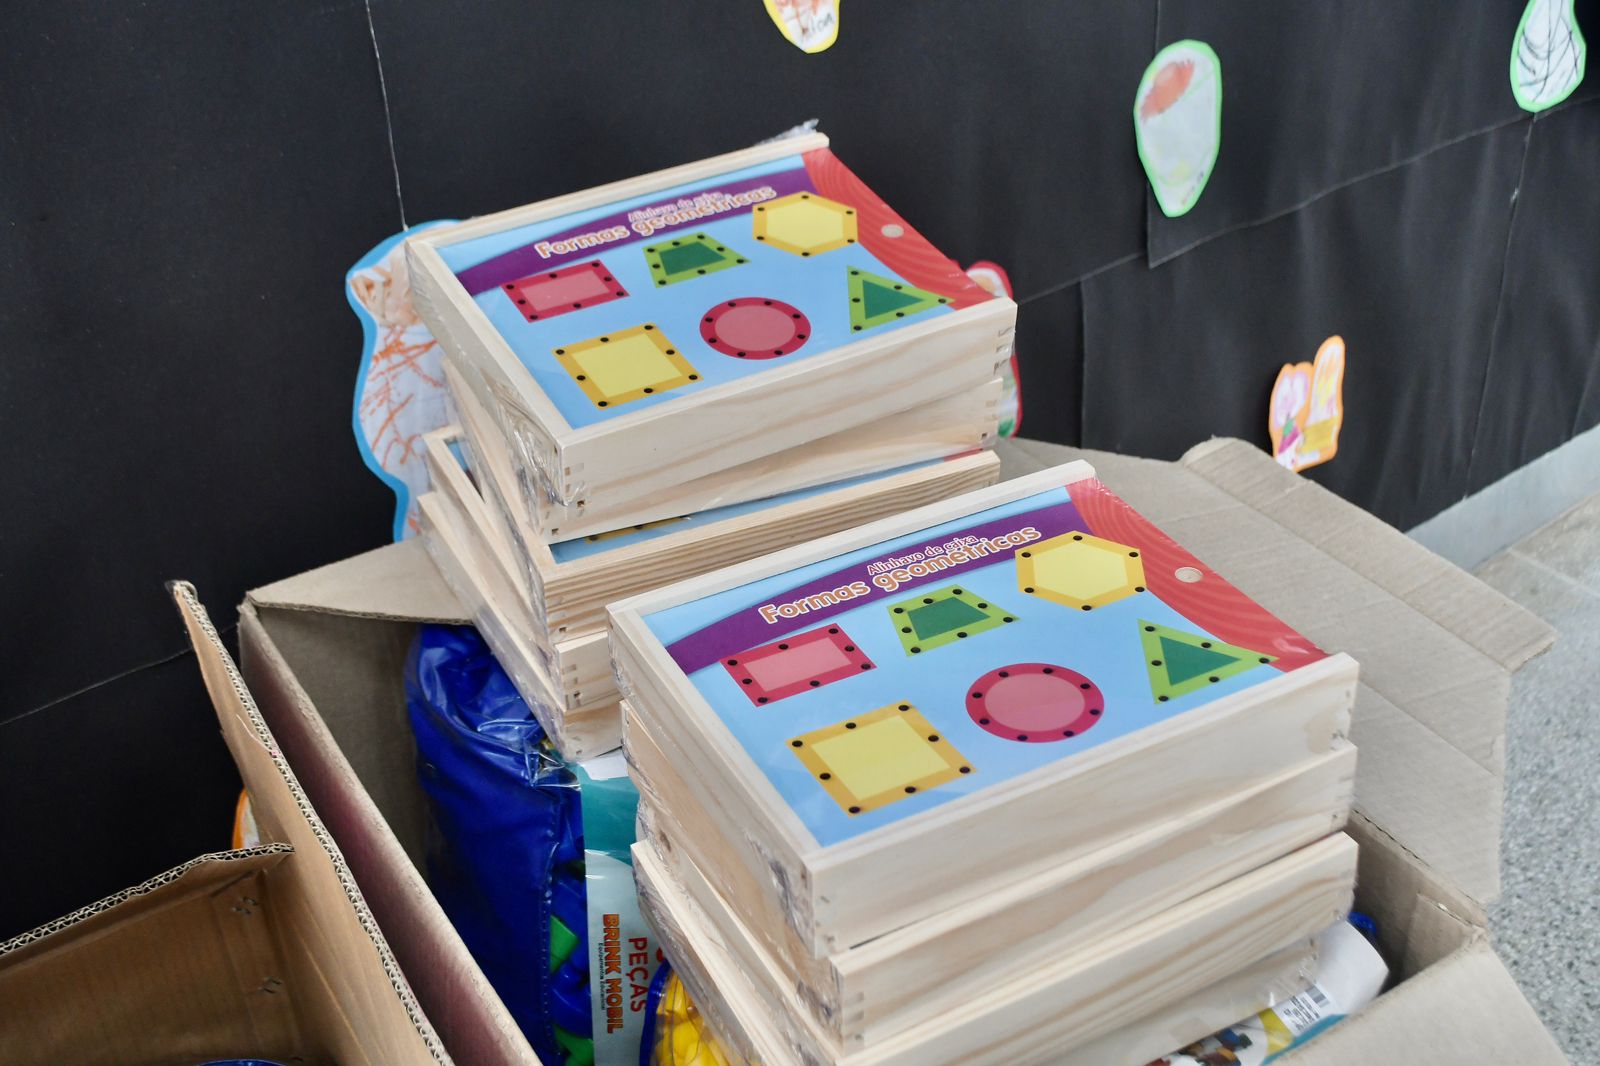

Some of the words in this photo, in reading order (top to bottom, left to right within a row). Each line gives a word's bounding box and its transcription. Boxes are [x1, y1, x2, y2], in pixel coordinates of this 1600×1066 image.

[534, 225, 630, 259] Formas
[759, 580, 871, 624] Formas
[872, 526, 1042, 592] geométricas
[867, 551, 925, 575] Alinhavo
[925, 545, 944, 557] de
[943, 535, 979, 551] caixa
[603, 914, 620, 974] BRINK
[626, 938, 649, 1012] PEÇAS
[607, 978, 623, 1033] MOBIL
